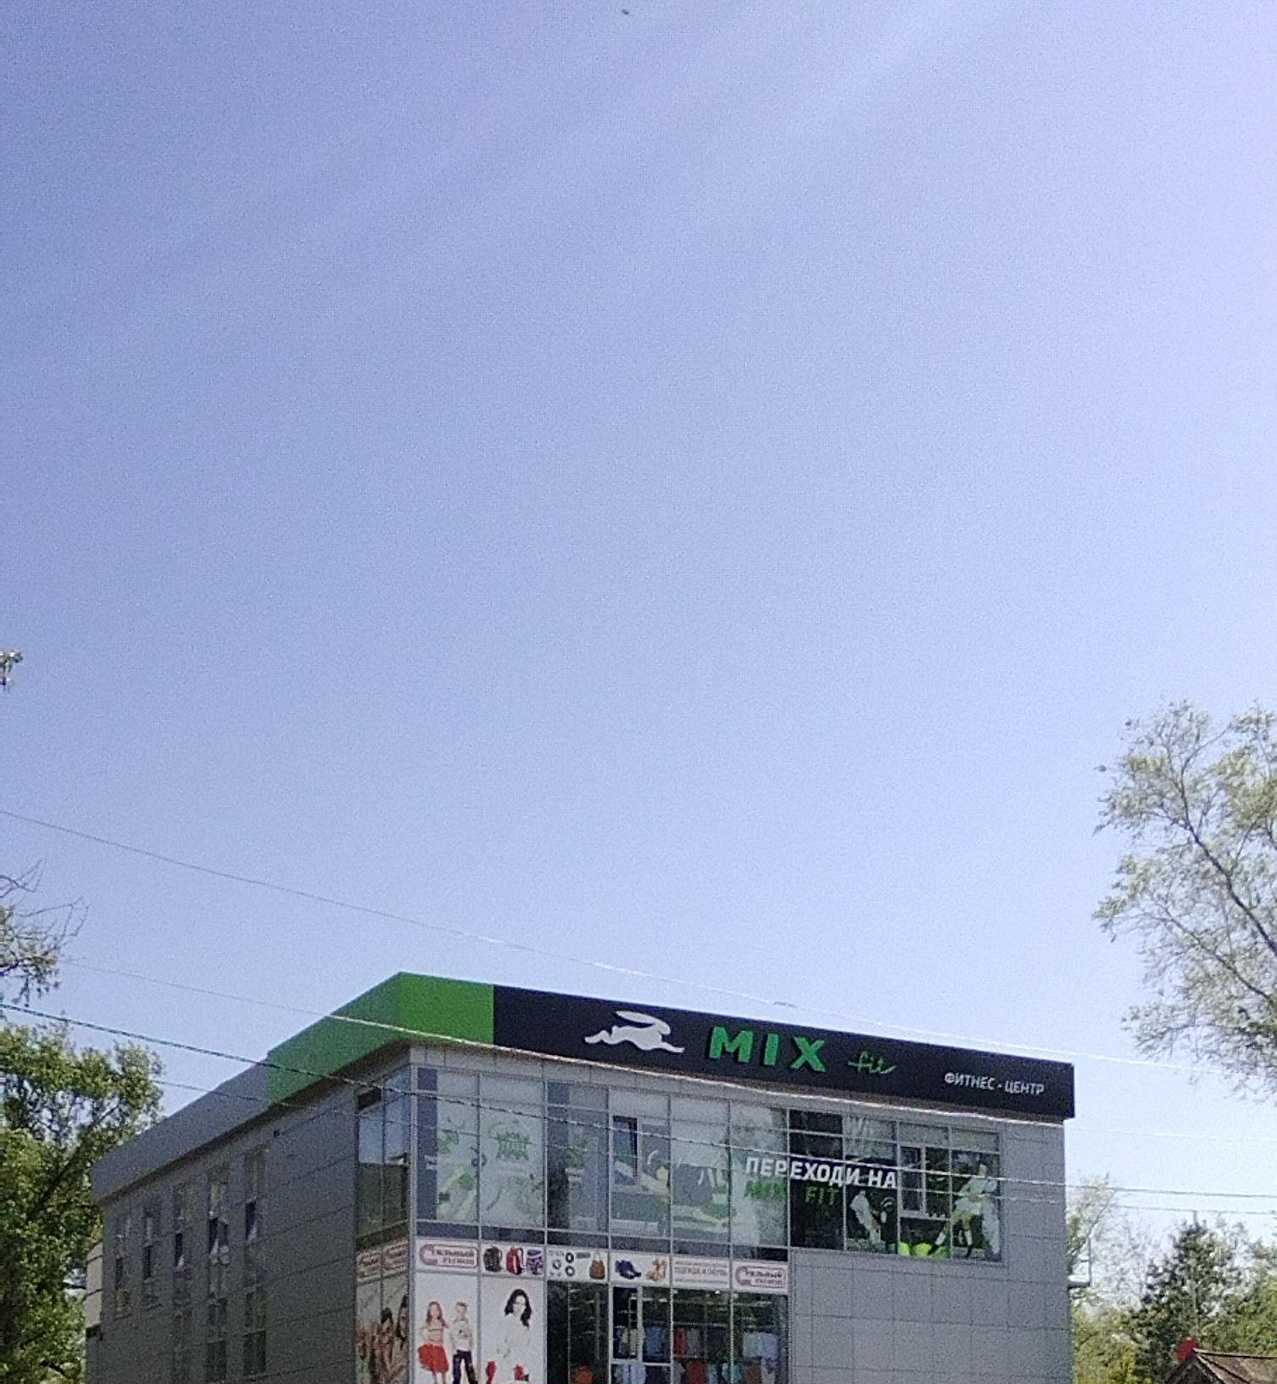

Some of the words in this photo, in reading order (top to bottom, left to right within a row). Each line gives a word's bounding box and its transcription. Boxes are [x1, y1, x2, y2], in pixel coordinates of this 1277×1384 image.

[709, 1026, 827, 1073] MIX
[944, 1072, 996, 1090] ФИТНЕС
[1004, 1080, 1045, 1096] ЦЕНТР
[745, 1156, 860, 1188] ПЕРЕХОДИ
[867, 1170, 898, 1189] НА
[804, 1185, 840, 1206] FIT
